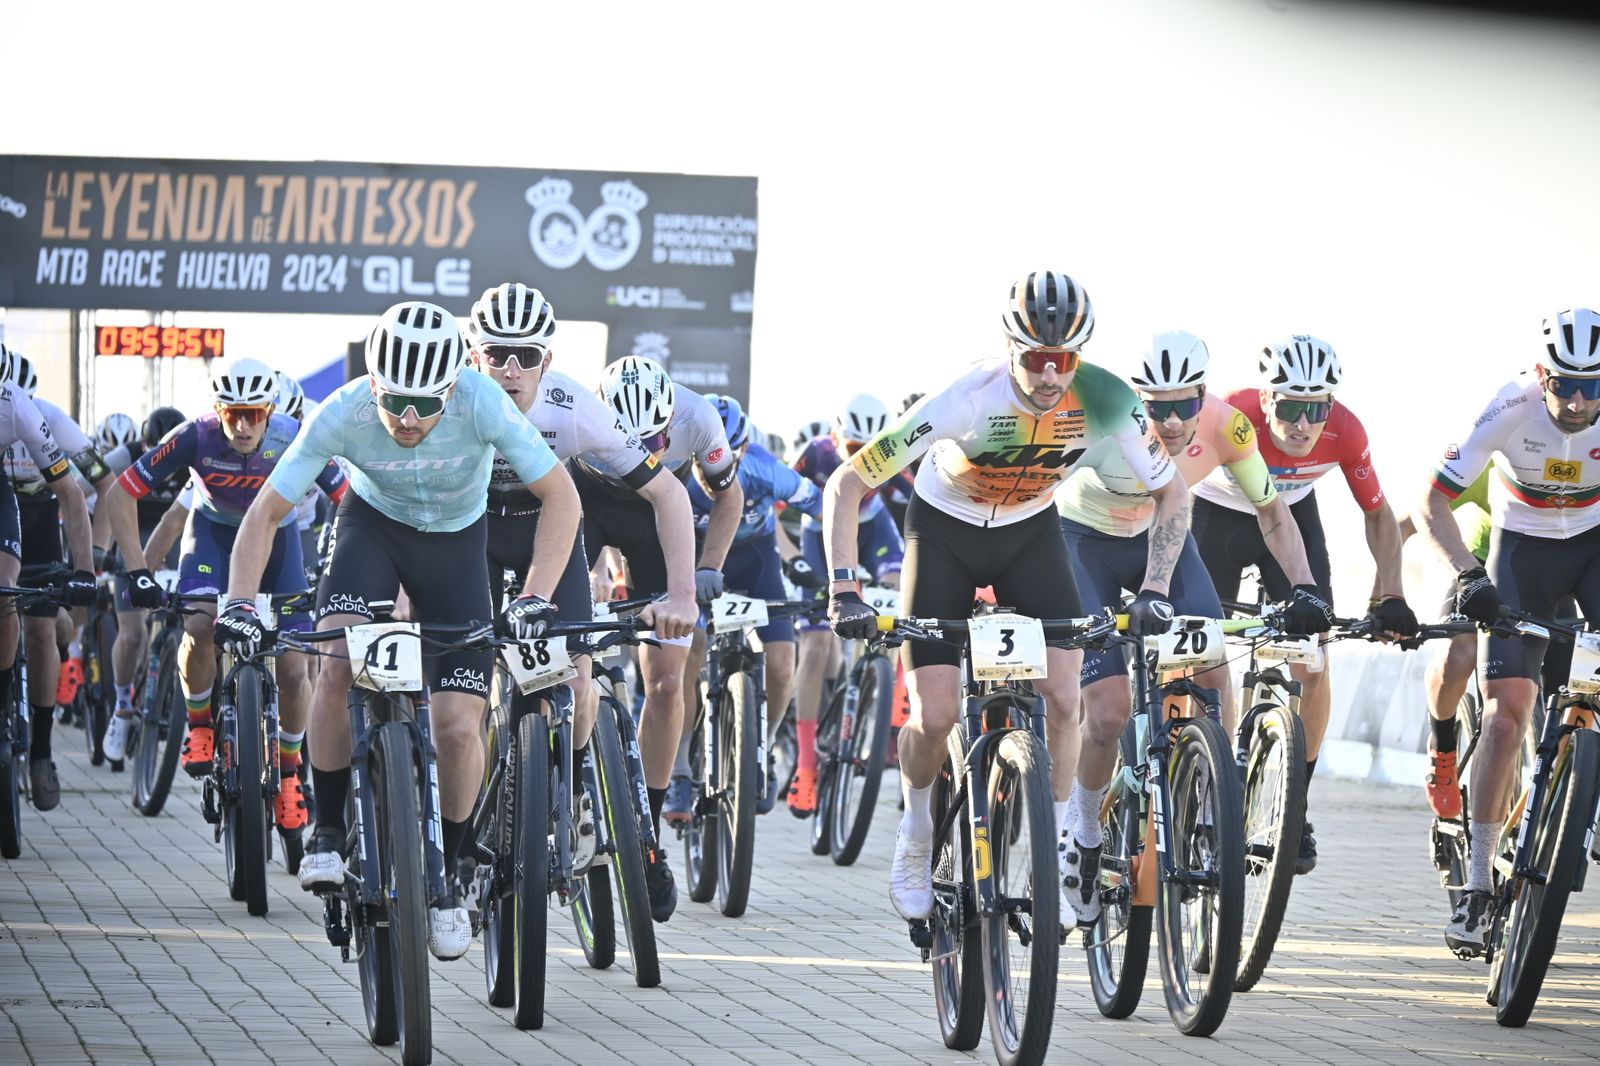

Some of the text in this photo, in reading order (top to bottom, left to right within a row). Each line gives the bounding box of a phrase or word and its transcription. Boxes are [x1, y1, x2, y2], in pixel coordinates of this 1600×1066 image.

[41, 171, 478, 250] LA LEYENDA DE TARTESSOS
[653, 230, 754, 250] PROVINCIAL
[668, 249, 735, 266] HUELVA
[36, 247, 349, 292] MTB RACE HUELVA 2024
[615, 285, 660, 308] UCI
[99, 325, 224, 358] 09:59:54
[362, 455, 470, 471] SCOTT
[968, 444, 1088, 469] KTM
[978, 470, 1062, 481] KOMETA
[329, 593, 365, 605] CALA
[725, 601, 753, 616] 27
[998, 629, 1015, 657] 3
[1172, 631, 1208, 655] 20
[367, 641, 398, 671] 11
[518, 639, 551, 671] 88
[441, 678, 488, 694] BANDIDA
[453, 668, 485, 682] CALA
